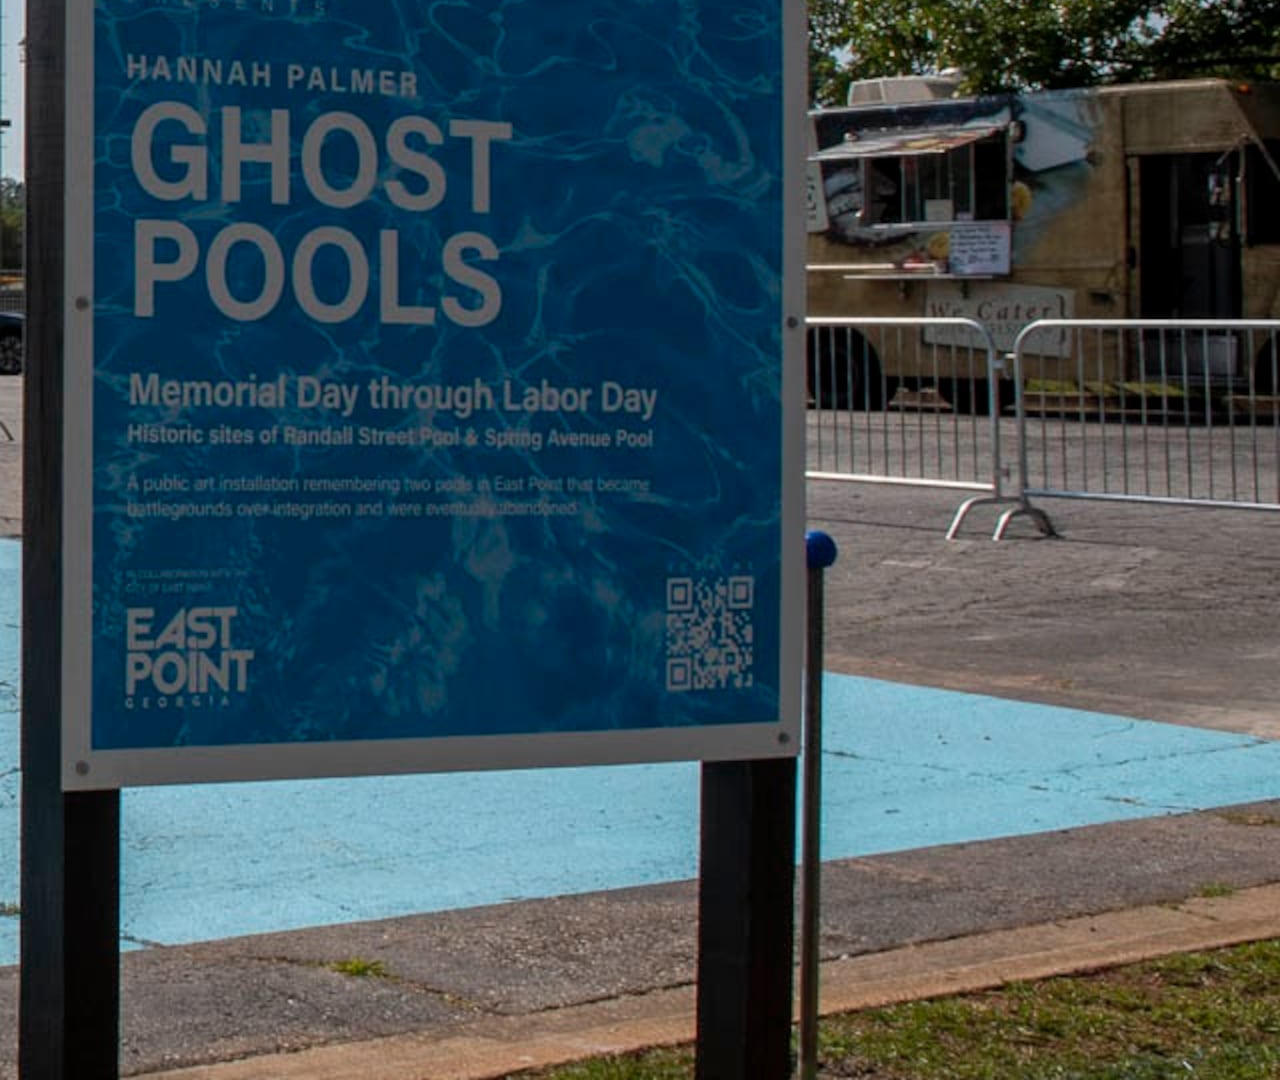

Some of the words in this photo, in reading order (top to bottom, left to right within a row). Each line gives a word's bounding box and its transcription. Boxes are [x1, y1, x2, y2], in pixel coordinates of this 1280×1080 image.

[127, 53, 272, 88] HANNAH
[287, 64, 418, 98] PALMER
[131, 100, 512, 214] GHOST
[133, 219, 503, 327] POOLS
[930, 301, 963, 318] We
[977, 301, 1054, 320] Cater
[129, 372, 287, 409] Memorial
[297, 375, 359, 417] Day
[369, 375, 494, 418] through
[503, 379, 593, 413] Labor
[602, 381, 658, 421] Day
[127, 424, 204, 445] Historic
[209, 425, 254, 445] sites
[259, 426, 280, 445] of
[284, 426, 353, 446] Randall
[358, 427, 416, 446] Street
[419, 427, 460, 447] Pool
[464, 428, 478, 447] &
[485, 428, 543, 451] Spring
[547, 429, 611, 448] Avenue
[615, 430, 654, 449] Pool
[127, 474, 138, 491] A
[143, 475, 189, 496] public
[193, 476, 216, 492] art
[220, 475, 299, 492] installation
[303, 476, 400, 496] remembering
[404, 477, 431, 492] two
[495, 476, 525, 492] East
[529, 476, 563, 492] Point
[567, 476, 593, 492] that
[597, 476, 651, 492] became
[127, 499, 233, 521] battlegrounds
[237, 503, 269, 517] over
[273, 501, 351, 520] integration
[355, 501, 383, 517] and
[387, 503, 421, 517] were
[126, 606, 238, 650] EAST
[126, 650, 255, 697] POINT
[124, 696, 230, 710] GEORGIA
